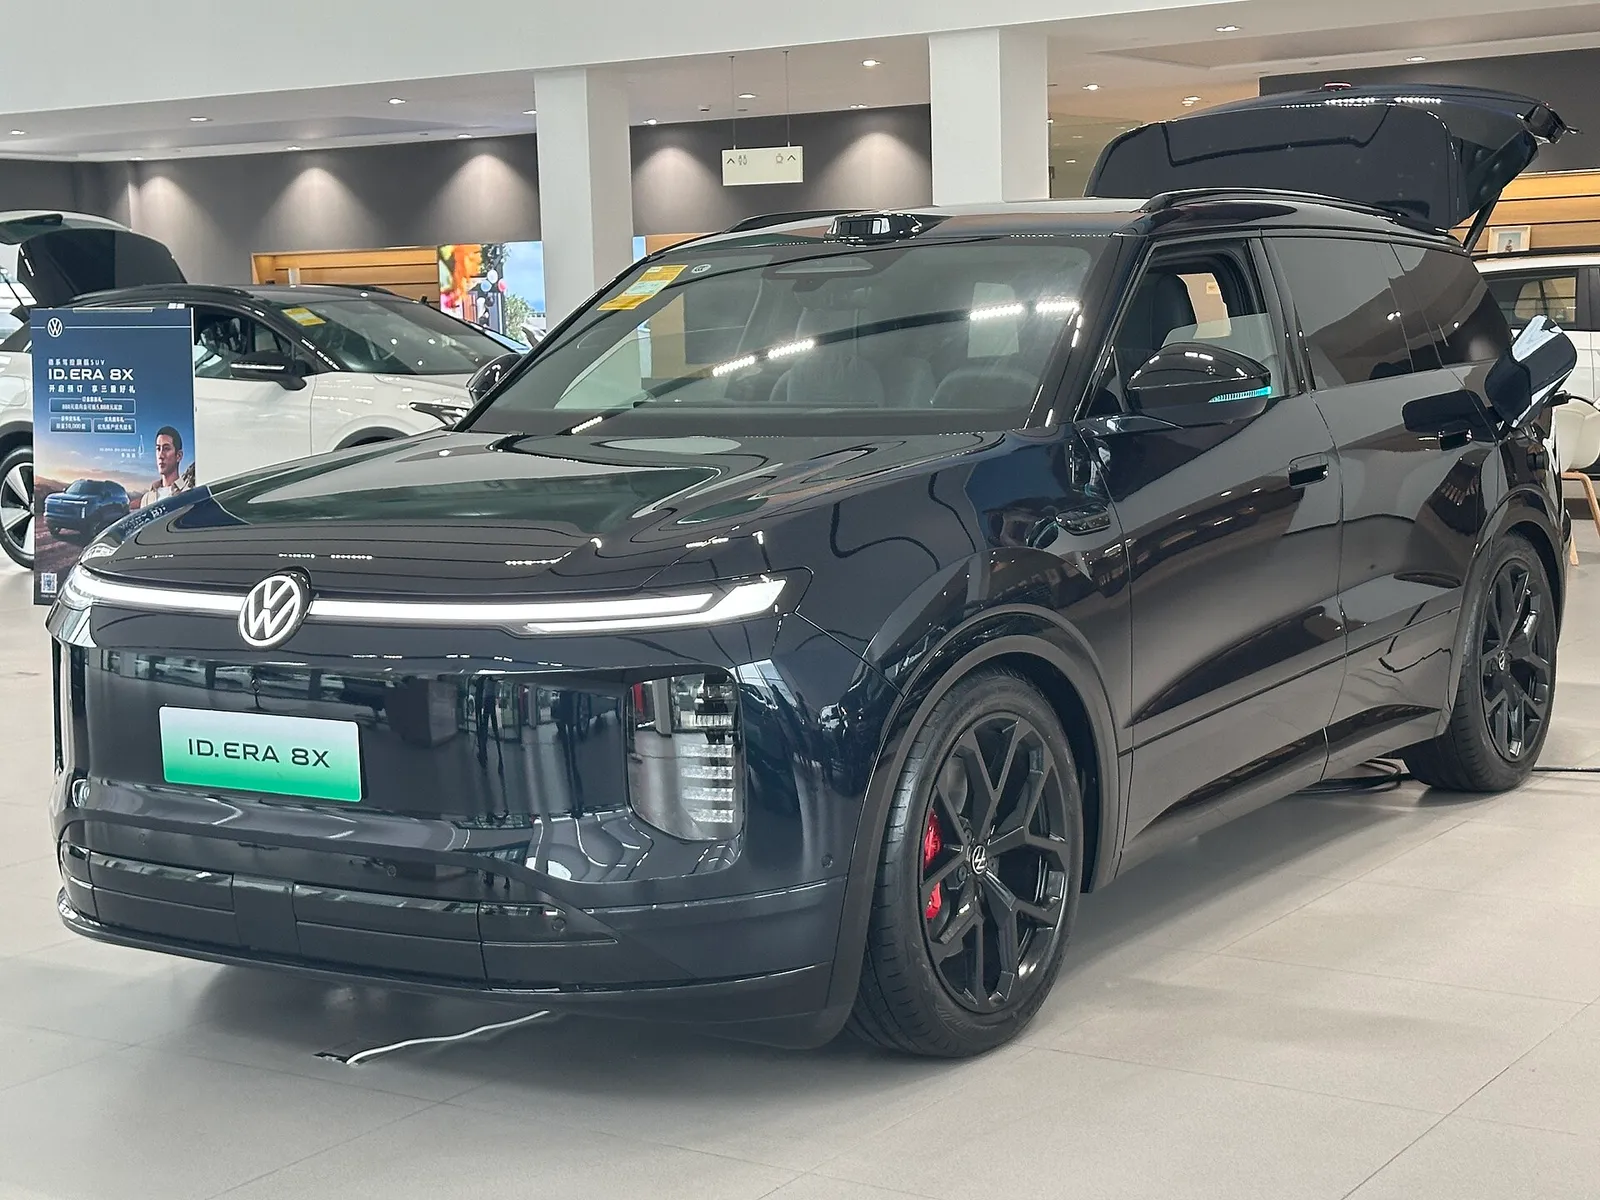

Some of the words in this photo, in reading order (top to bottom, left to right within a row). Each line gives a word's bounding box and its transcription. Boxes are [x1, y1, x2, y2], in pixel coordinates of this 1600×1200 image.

[48, 368, 104, 380] ID.ERA
[109, 368, 134, 380] 8X
[188, 738, 280, 763] ID.ERA
[291, 748, 331, 768] 8X
